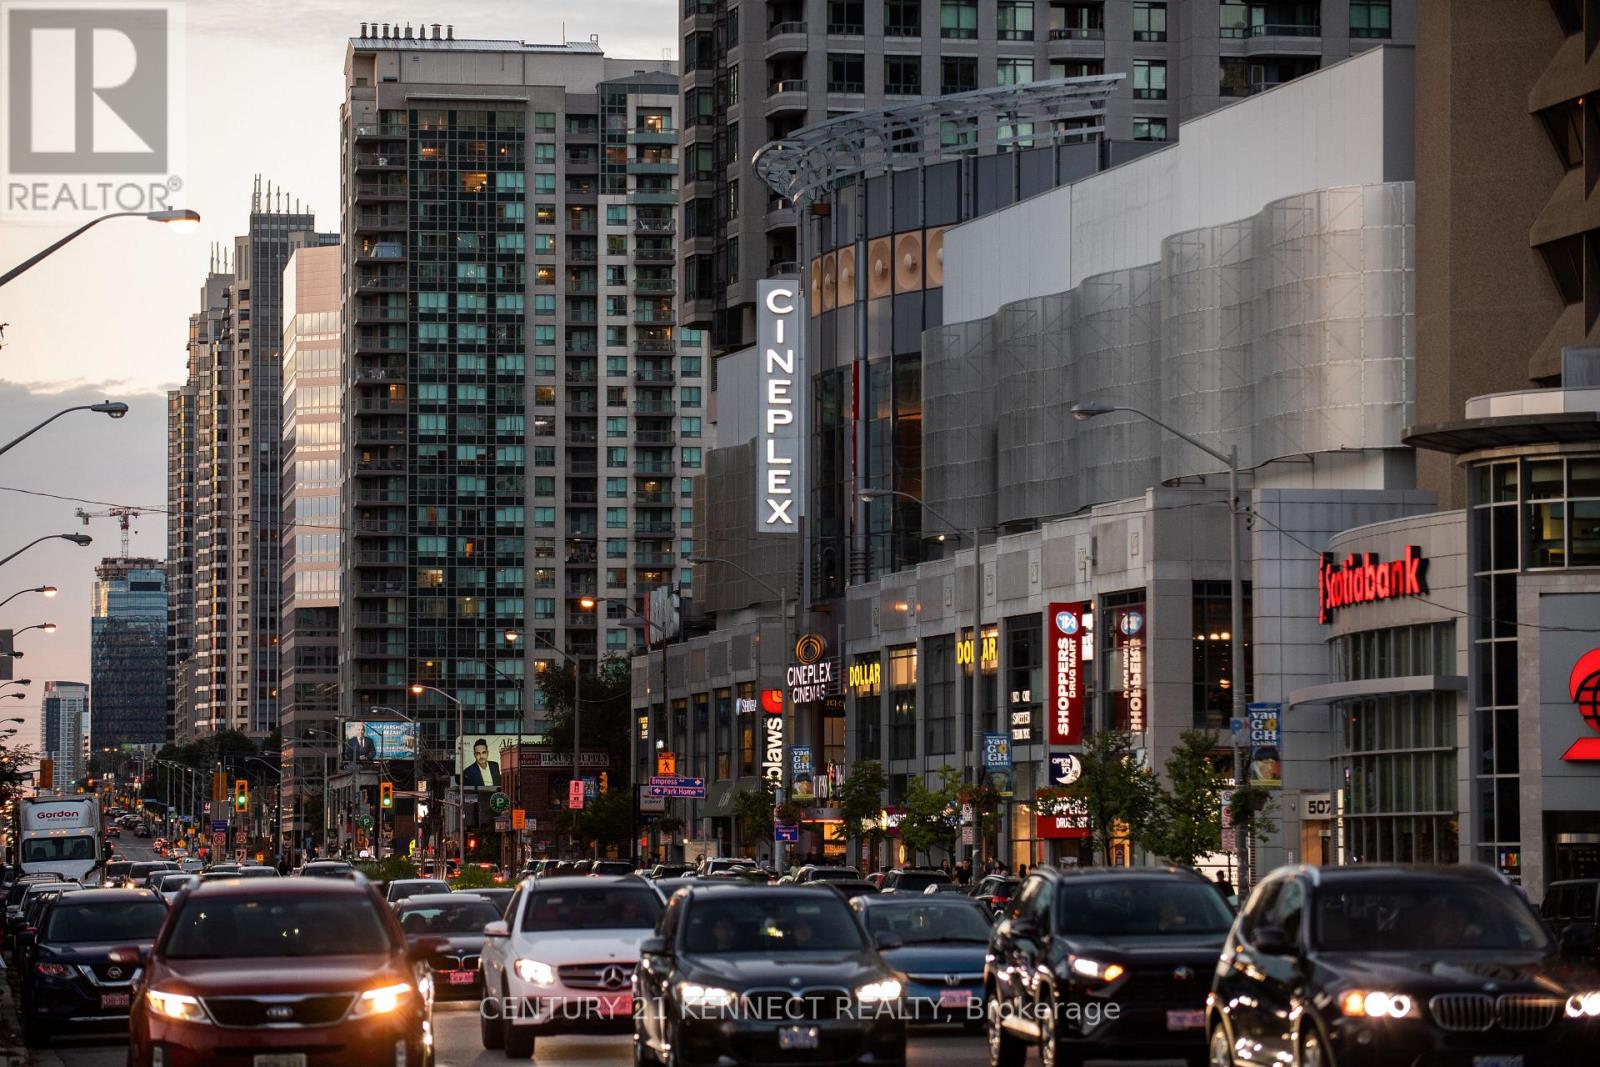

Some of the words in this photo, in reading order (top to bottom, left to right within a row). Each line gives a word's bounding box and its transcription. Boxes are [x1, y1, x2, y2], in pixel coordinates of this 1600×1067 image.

[766, 288, 794, 525] CINEPLEX
[1325, 544, 1421, 610] Scotiabank
[787, 662, 831, 687] CINEPLEX
[849, 663, 880, 687] DOLLAR
[1058, 637, 1069, 736] SHOPPERS
[792, 685, 826, 704] CINEMAS
[1052, 757, 1070, 765] OPEN
[36, 810, 79, 820] Gordon
